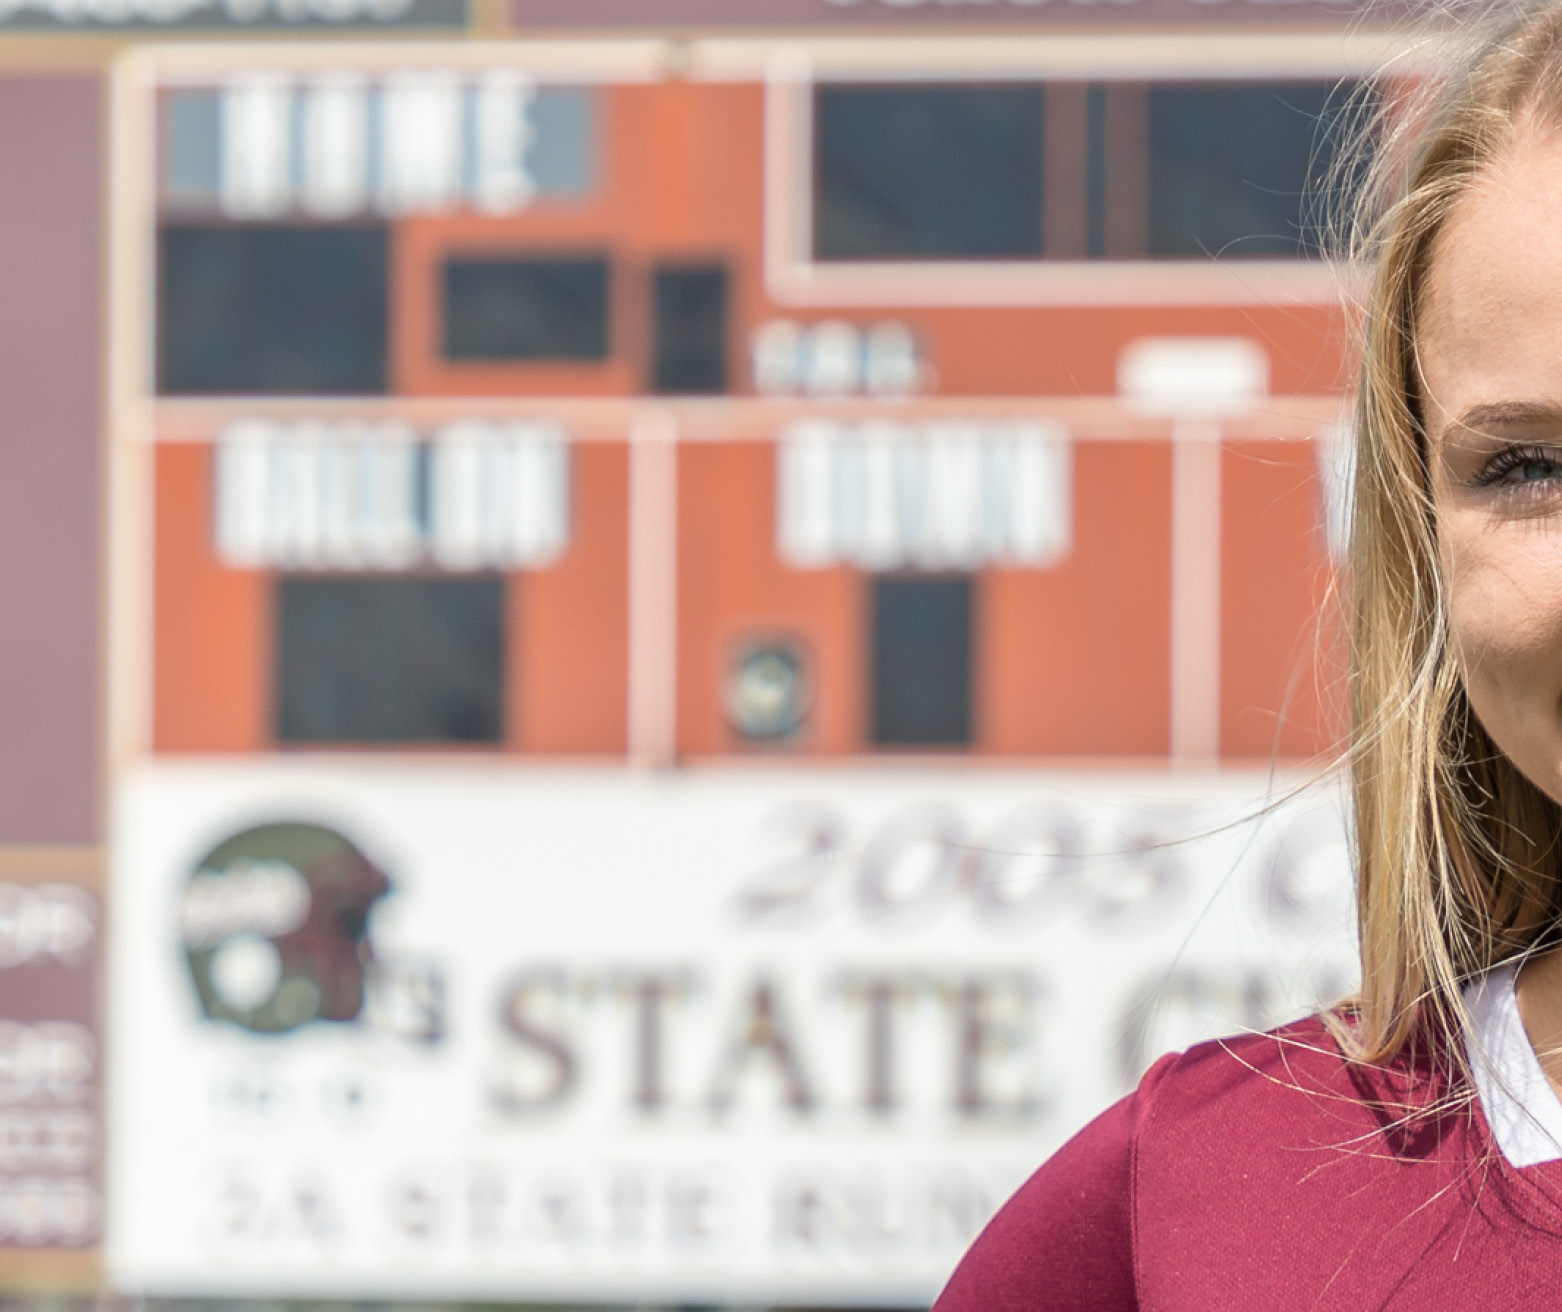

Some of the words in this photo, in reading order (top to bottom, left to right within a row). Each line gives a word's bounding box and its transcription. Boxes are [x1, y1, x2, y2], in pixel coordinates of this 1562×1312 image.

[733, 800, 1190, 932] 2005
[488, 960, 1052, 1125] STATE
[390, 1165, 722, 1252] STATE
